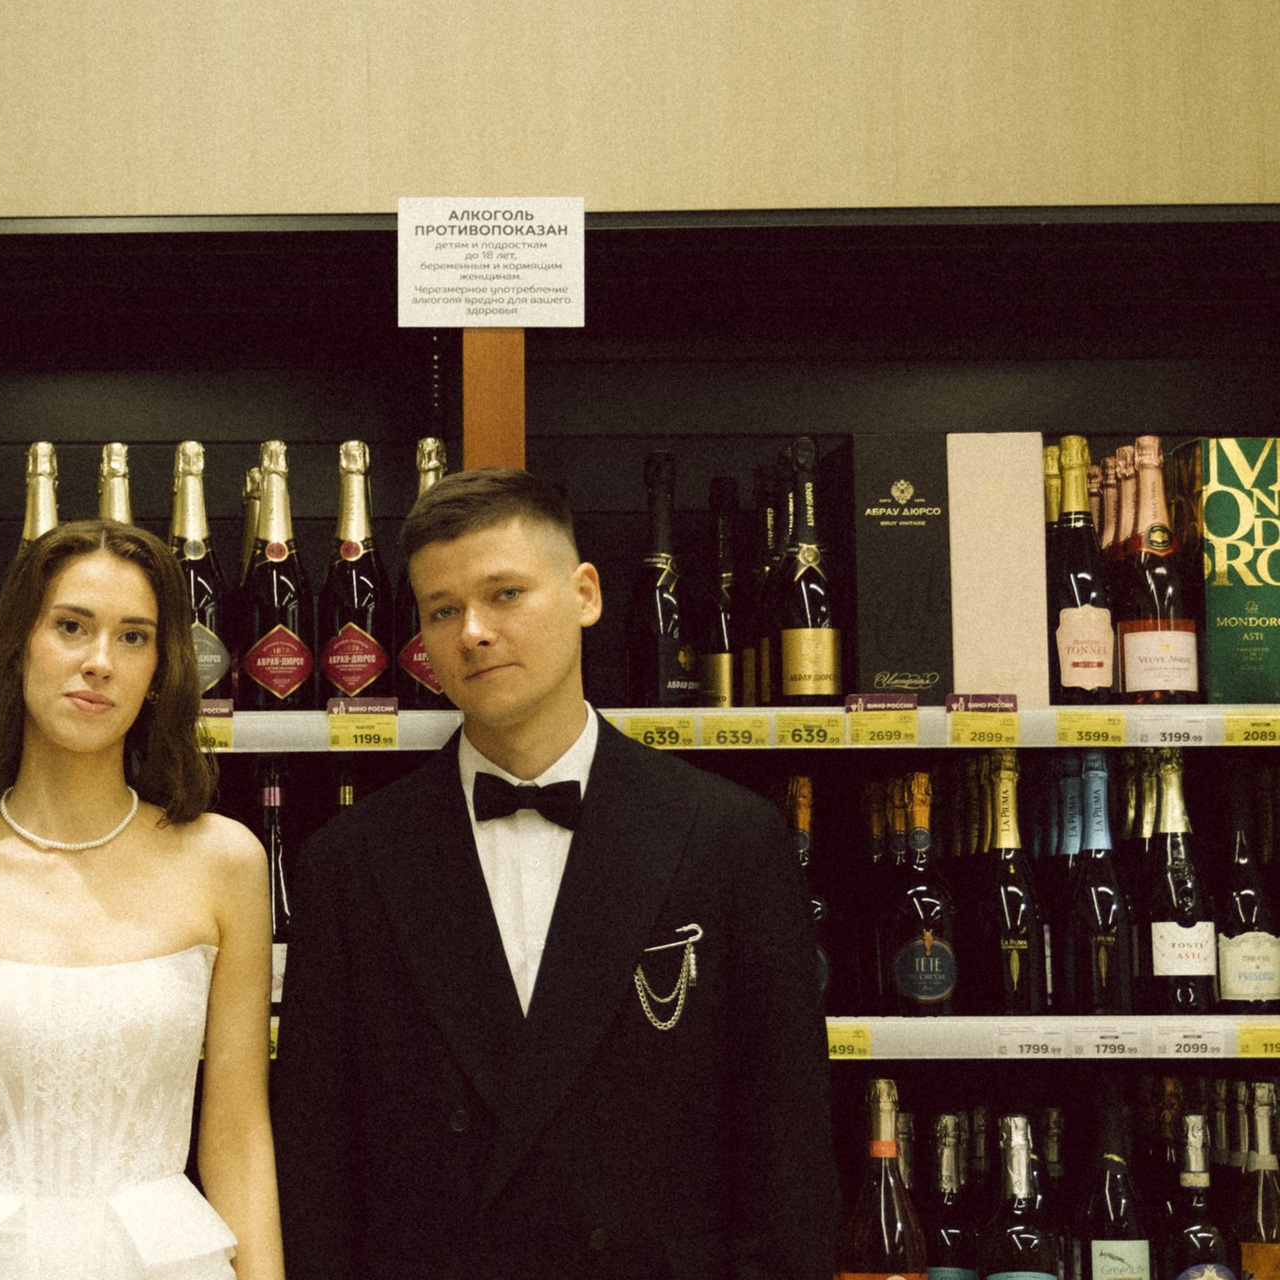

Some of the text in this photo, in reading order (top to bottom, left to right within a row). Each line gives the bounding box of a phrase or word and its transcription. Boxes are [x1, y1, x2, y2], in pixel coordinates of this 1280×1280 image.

[448, 210, 534, 221] АЛКОГОЛЬ
[414, 225, 568, 236] ПРОТИВОПОКАЗАН
[435, 241, 468, 250] детям
[481, 241, 547, 250] подросткам
[465, 252, 479, 261] до
[482, 251, 493, 260] 18
[420, 262, 490, 271] беременным
[503, 262, 562, 271] кормящим
[490, 285, 568, 296] употребление
[411, 297, 571, 306] алкоголя вредно для вашего
[465, 307, 518, 316] здоровья
[865, 507, 941, 516] АБРАУ ДЮРСО
[1242, 632, 1264, 641] ASTI
[1066, 645, 1109, 655] TONNEL
[353, 733, 393, 745] 1199.99
[643, 730, 692, 746] 639.99
[791, 728, 840, 744] 639.99
[1159, 731, 1203, 743] 3199.99
[1243, 729, 1280, 741] 2089.
[1001, 789, 1010, 832] LA PIUMA
[1093, 788, 1101, 832] LA PIUMA
